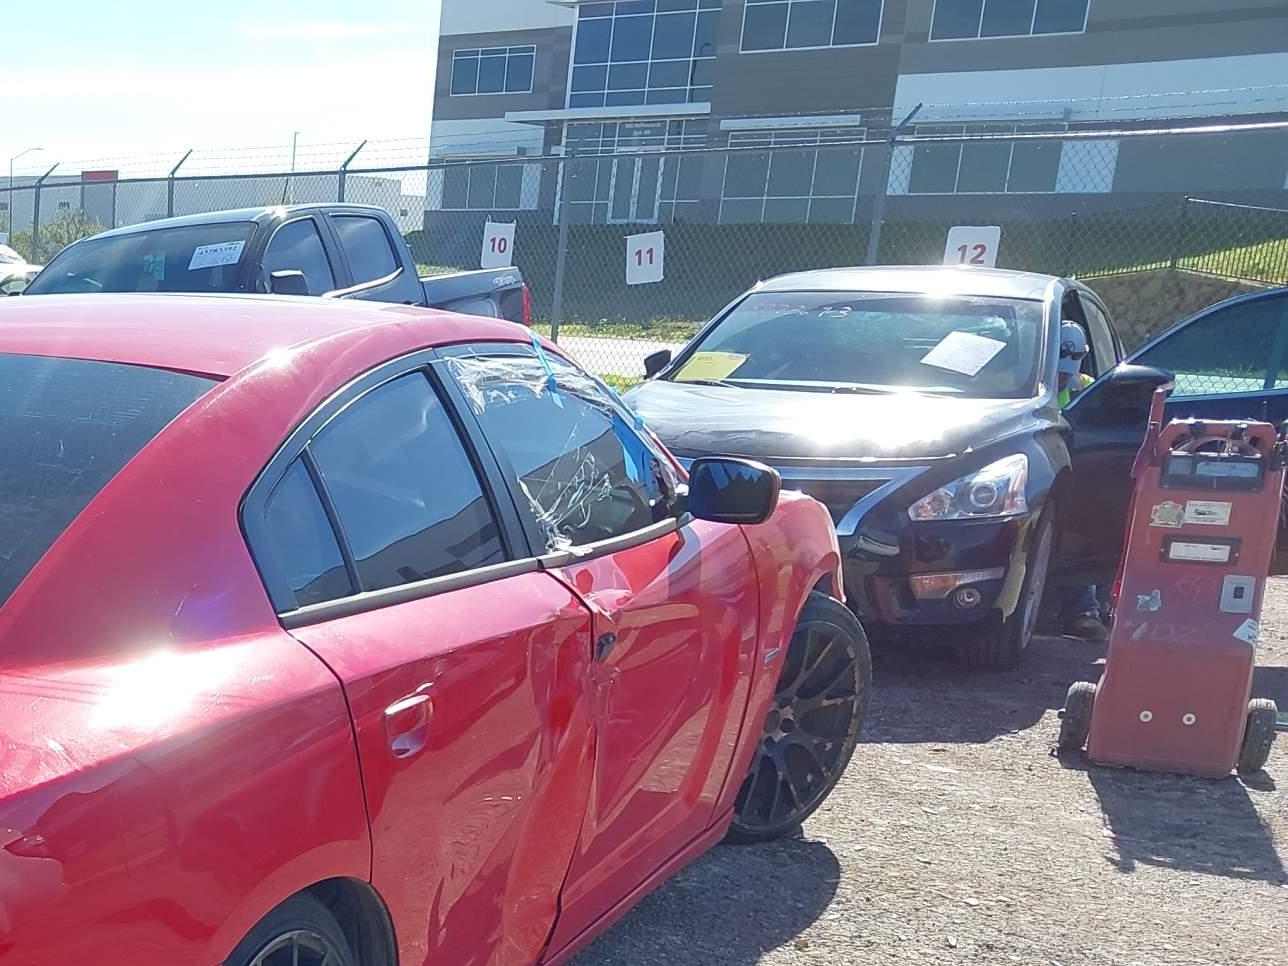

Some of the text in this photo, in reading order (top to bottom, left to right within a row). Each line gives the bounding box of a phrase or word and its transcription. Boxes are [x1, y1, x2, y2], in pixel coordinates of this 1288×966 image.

[489, 236, 508, 255] 10
[957, 243, 987, 265] 12
[634, 247, 654, 267] 11
